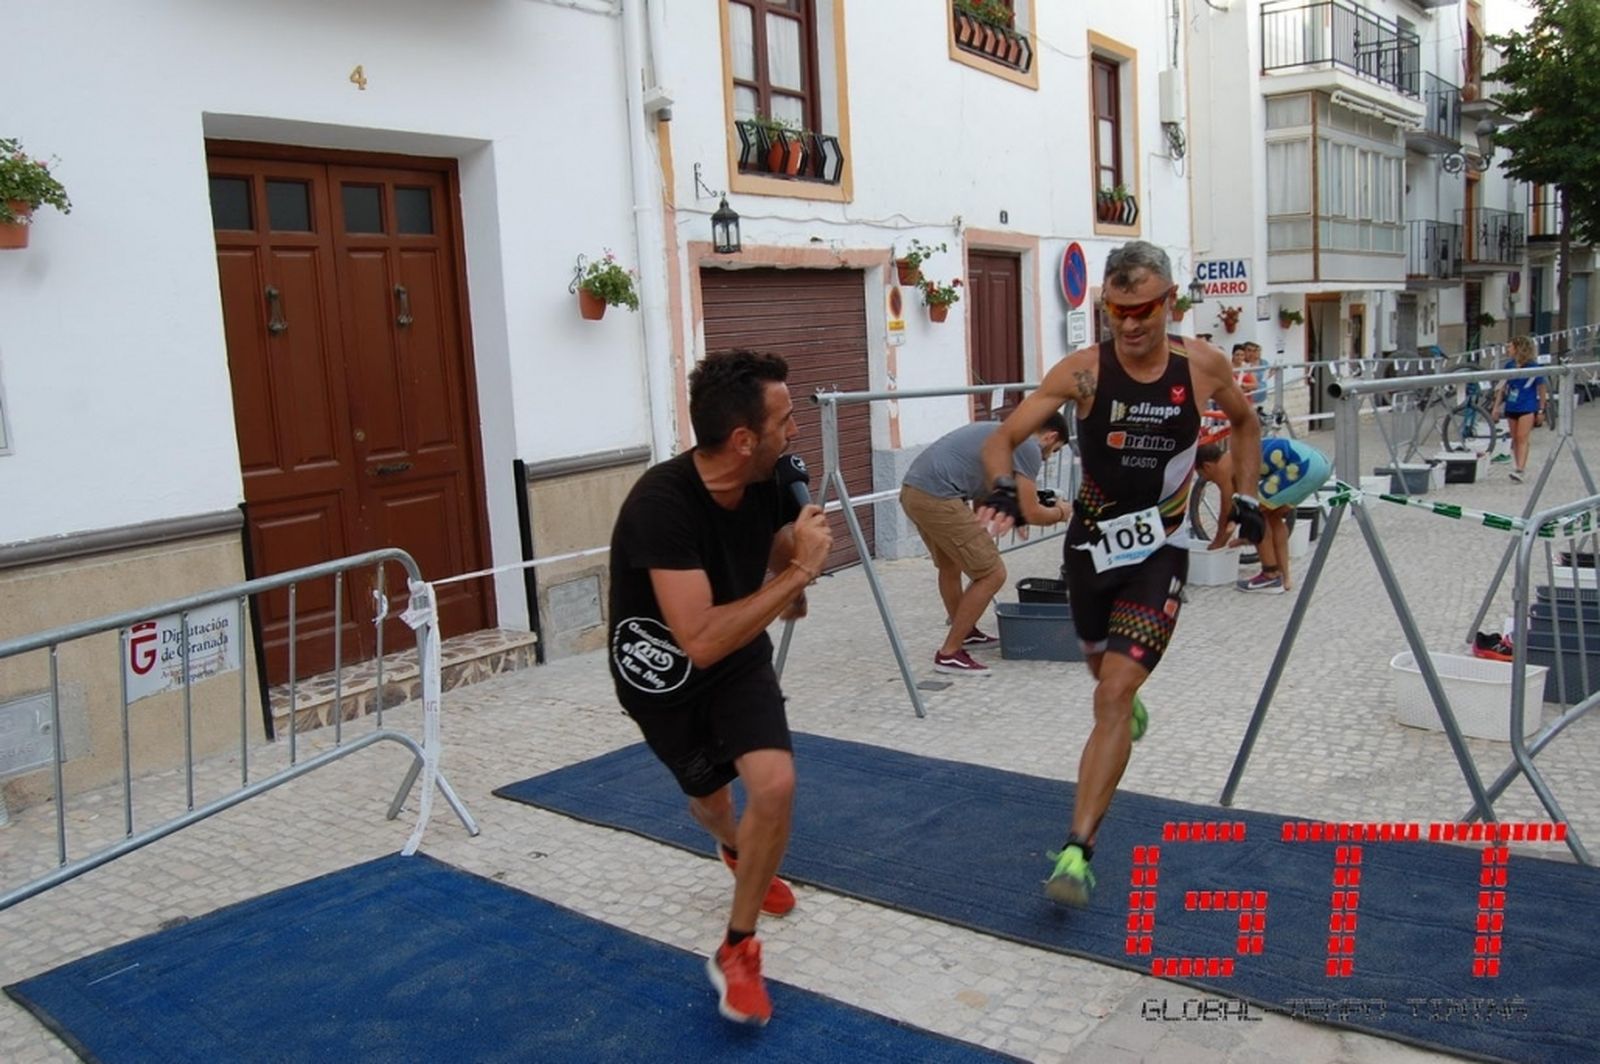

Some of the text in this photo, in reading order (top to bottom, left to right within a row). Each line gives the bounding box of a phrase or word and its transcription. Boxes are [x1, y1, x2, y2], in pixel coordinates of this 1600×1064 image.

[350, 64, 367, 91] 4
[1196, 260, 1247, 280] CERIA
[1129, 402, 1181, 419] olimpo
[1101, 523, 1155, 555] 108
[161, 646, 175, 662] de
